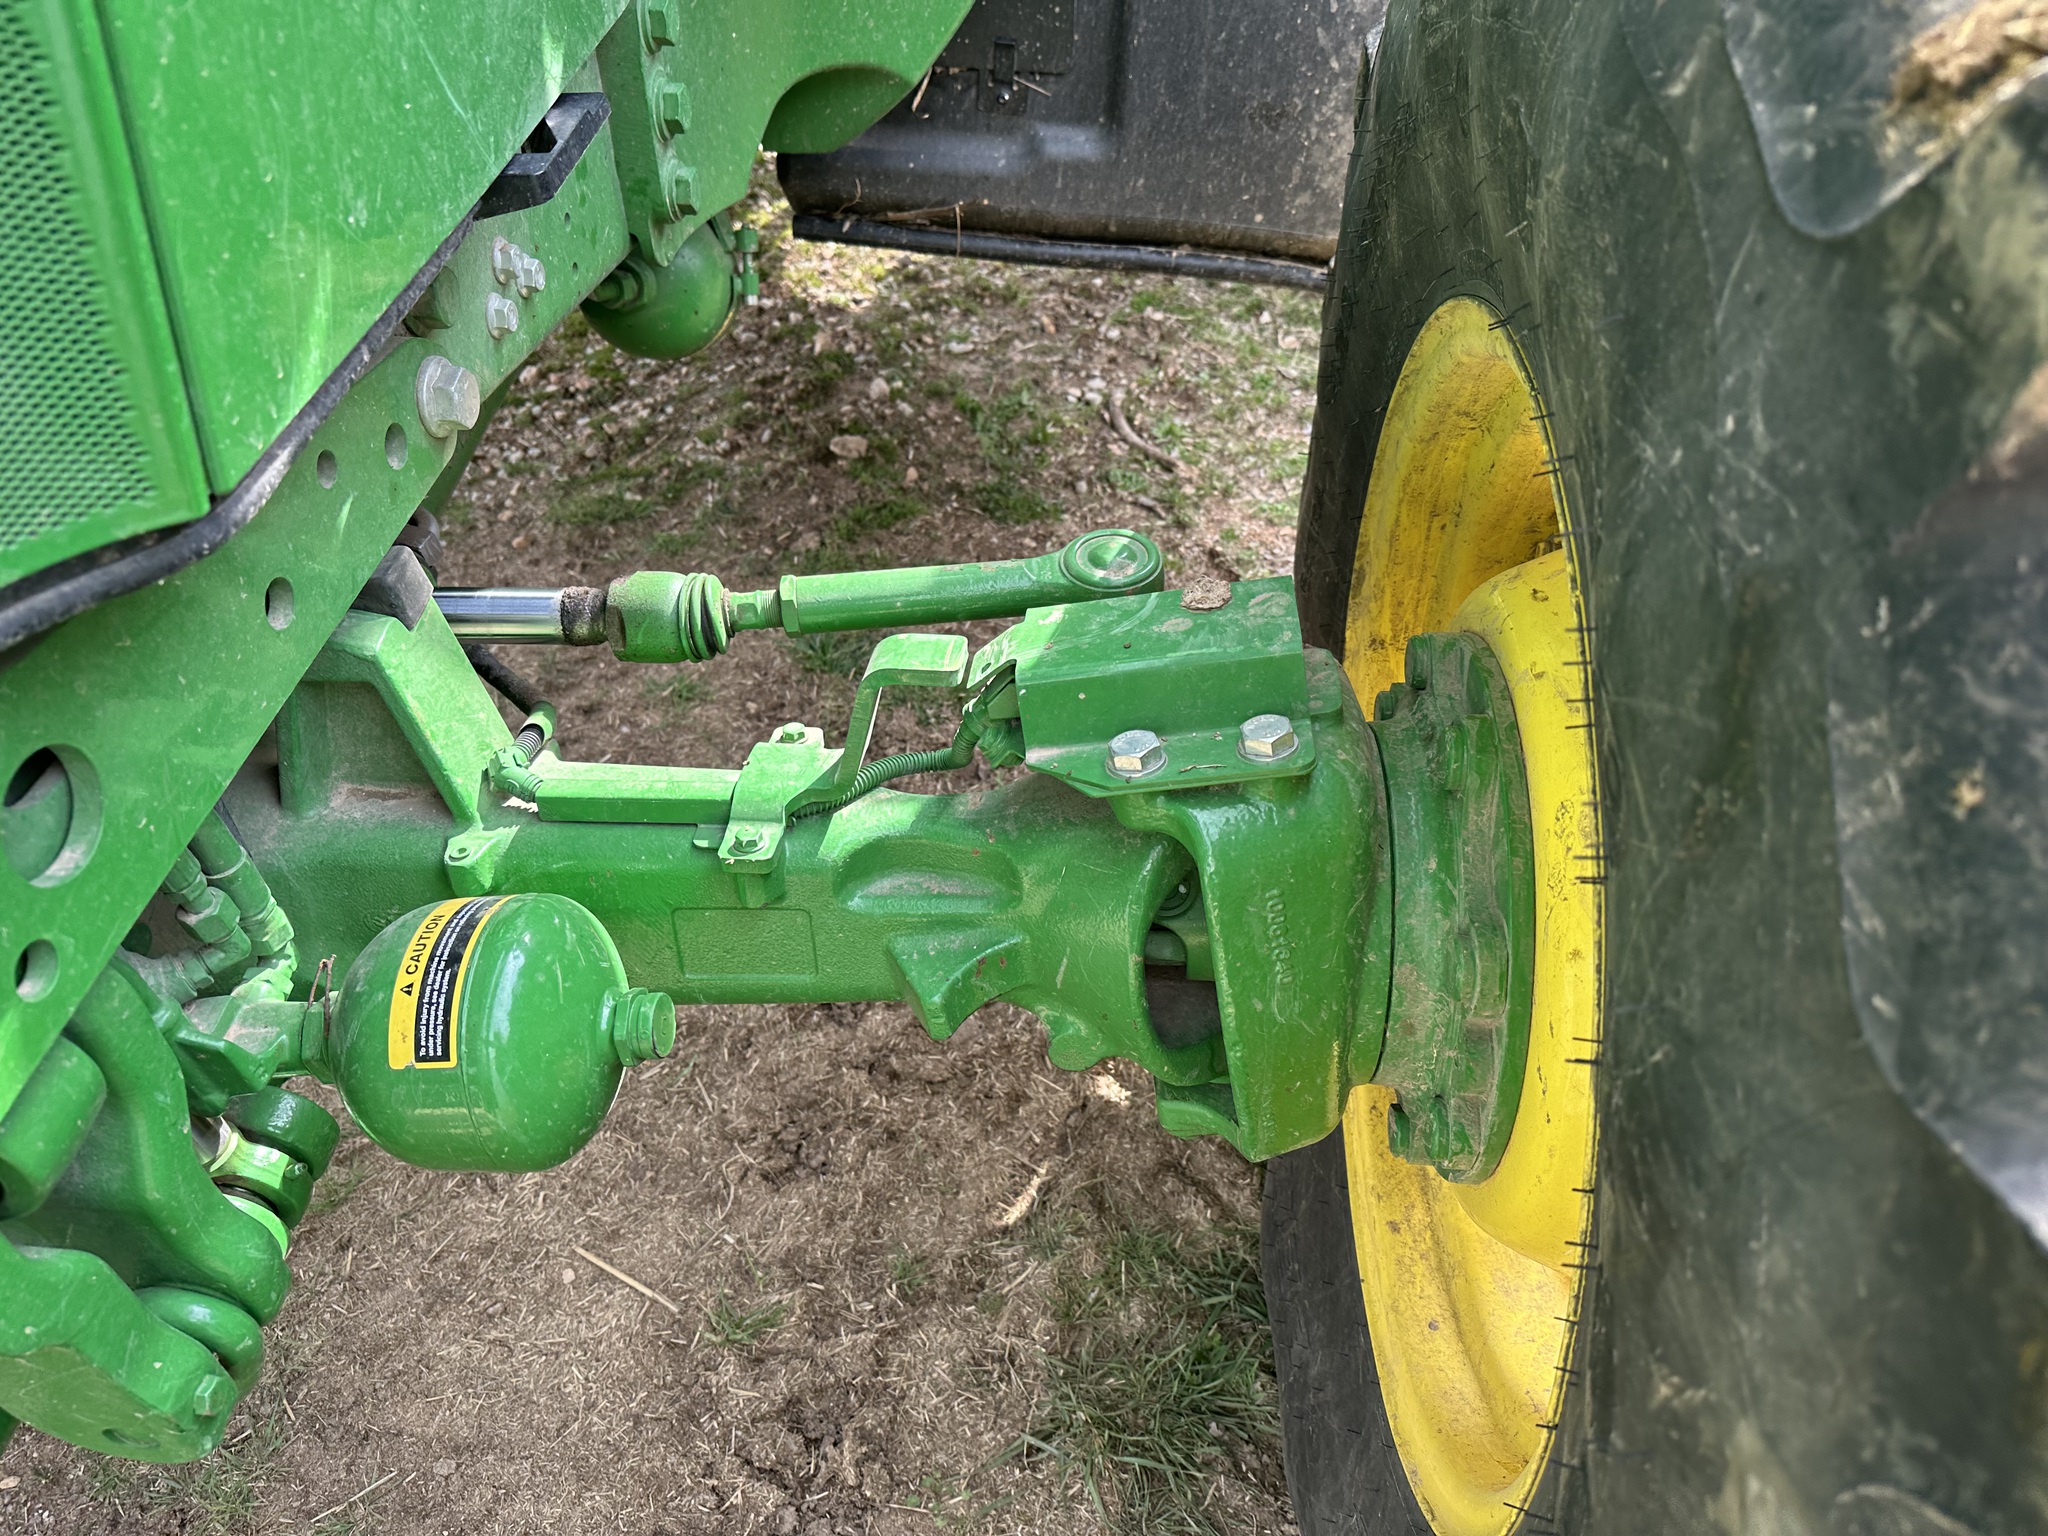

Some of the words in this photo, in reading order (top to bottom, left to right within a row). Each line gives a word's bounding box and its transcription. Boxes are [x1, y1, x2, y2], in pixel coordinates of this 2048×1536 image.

[405, 914, 445, 975] CAUTION
[427, 957, 440, 985] machine
[422, 986, 432, 1003] from
[420, 1004, 429, 1024] injury
[419, 1026, 427, 1046] avoid
[427, 1036, 435, 1056] under
[419, 1047, 427, 1056] To
